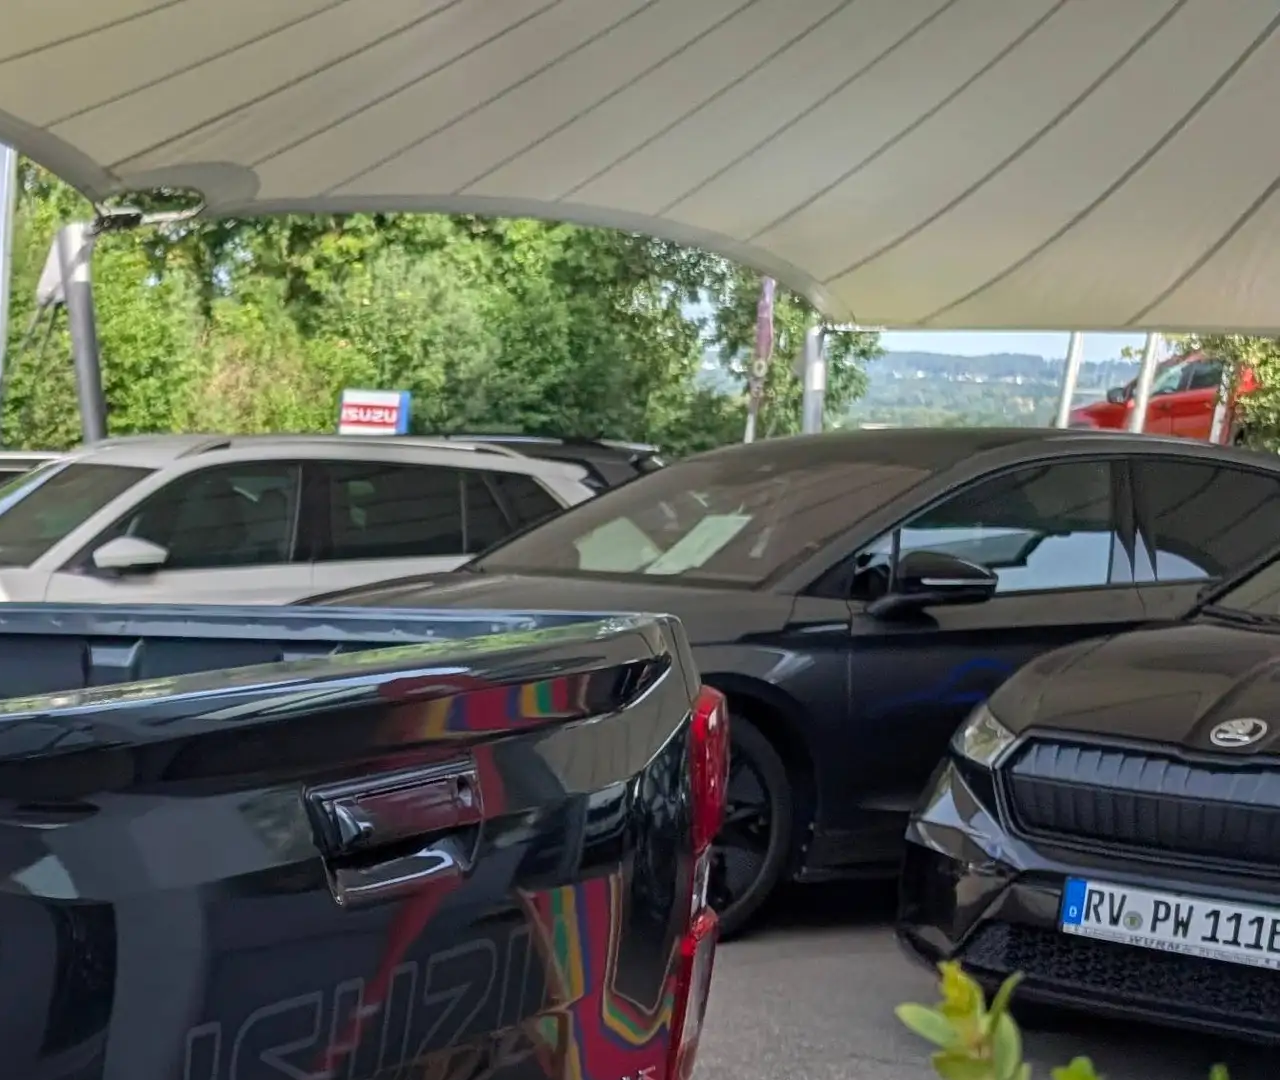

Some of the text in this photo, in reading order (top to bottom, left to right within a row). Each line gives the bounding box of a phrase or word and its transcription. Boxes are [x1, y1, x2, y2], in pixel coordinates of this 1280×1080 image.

[340, 405, 398, 424] ISUZU
[1084, 888, 1127, 927] RV
[1149, 899, 1194, 939] PW
